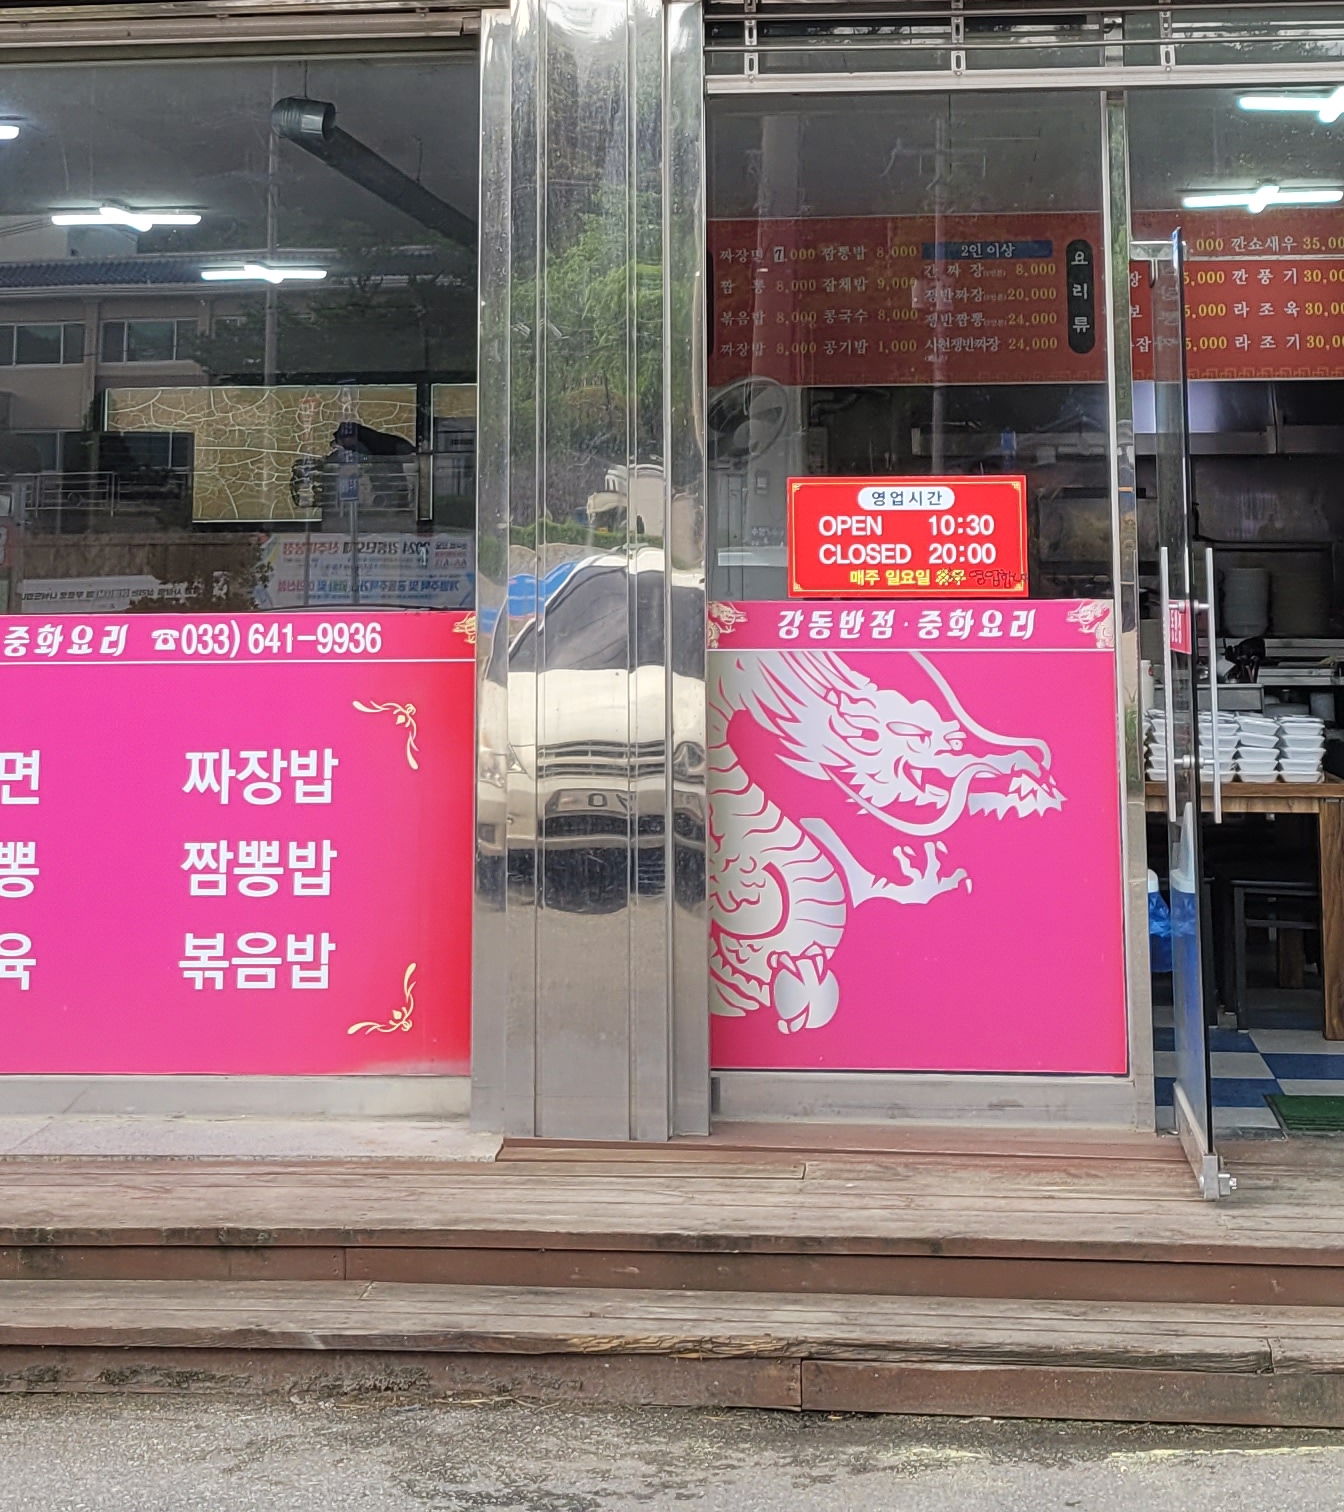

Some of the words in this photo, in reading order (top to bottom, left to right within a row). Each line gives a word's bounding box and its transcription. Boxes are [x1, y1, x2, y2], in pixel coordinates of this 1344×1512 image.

[961, 245, 982, 259] 2인
[987, 243, 1015, 258] 이상
[1230, 234, 1297, 252] 깐쇼새우
[823, 309, 868, 324] 콩국수
[823, 340, 868, 355] 공기밥
[870, 489, 943, 508] 영업시간
[818, 515, 883, 537] OPEN
[928, 514, 995, 536] 10:30
[819, 543, 912, 565] CLOSED
[928, 543, 997, 565] 20:00
[848, 569, 880, 586] 매주
[885, 568, 931, 586] 일요일
[917, 608, 1037, 640] 중화요리
[3, 623, 129, 657] 중화요리
[182, 747, 339, 806] 짜장밥
[180, 839, 338, 898] 짬뽕밥
[178, 931, 337, 991] 볶음밥
